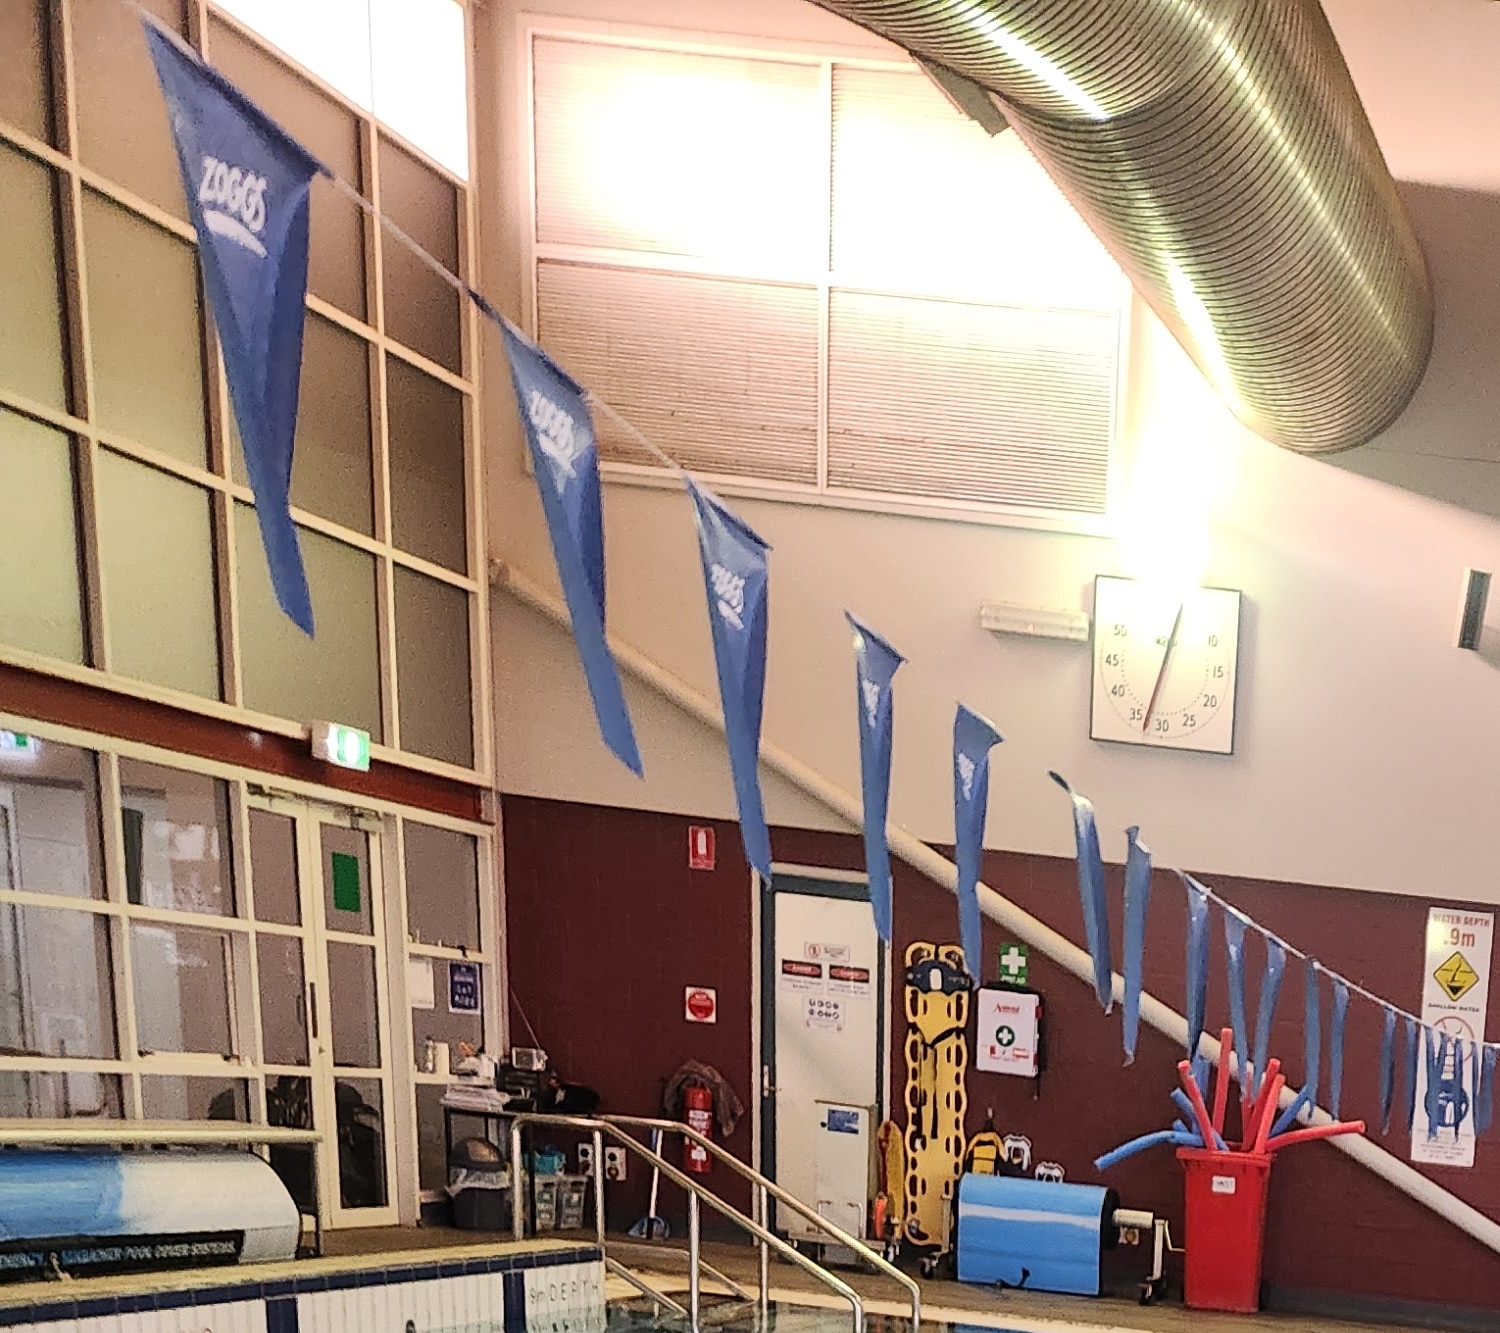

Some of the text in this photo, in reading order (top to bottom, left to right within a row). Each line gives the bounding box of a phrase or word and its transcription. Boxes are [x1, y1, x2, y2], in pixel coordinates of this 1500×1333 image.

[199, 155, 267, 233] ZOGGS
[1114, 624, 1127, 637] 50
[1208, 634, 1218, 647] 10
[1105, 653, 1119, 667] 45
[1212, 665, 1223, 678] 15
[1111, 684, 1125, 697] 40
[1202, 694, 1217, 707] 20
[1129, 707, 1143, 722] 35
[1182, 713, 1196, 727] 25
[1155, 718, 1169, 732] 30
[1433, 913, 1489, 927] WATER DEPTH
